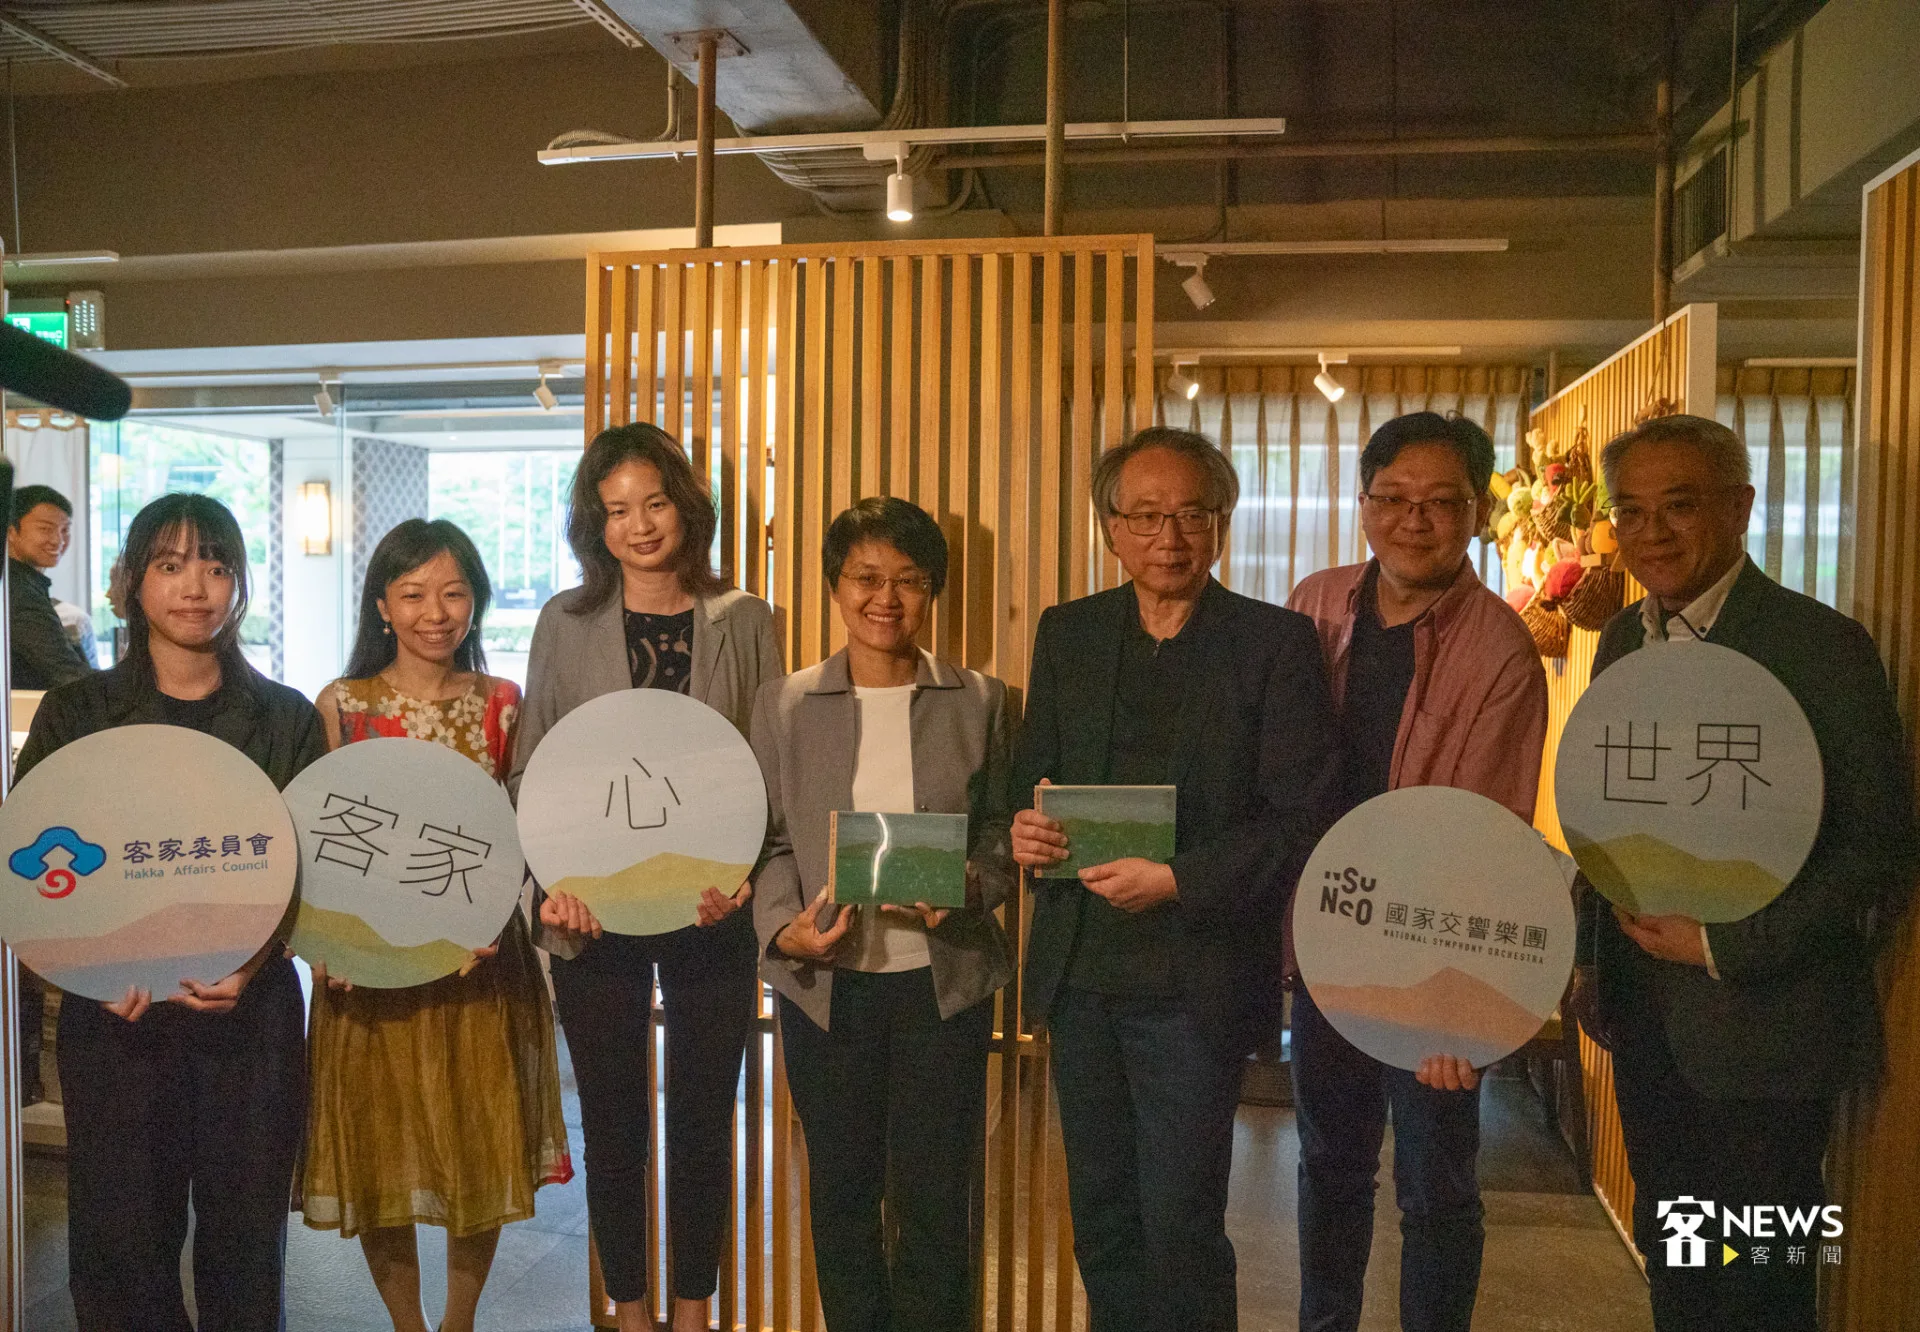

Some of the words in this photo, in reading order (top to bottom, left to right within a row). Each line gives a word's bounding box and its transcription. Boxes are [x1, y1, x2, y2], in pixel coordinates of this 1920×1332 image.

[1595, 721, 1771, 810] 世界
[605, 757, 681, 829] 心
[123, 832, 274, 864] 客家委員會
[124, 867, 165, 879] Hakka
[174, 864, 216, 876] Affairs
[222, 859, 268, 872] Council
[310, 793, 492, 904] 客家
[1383, 928, 1428, 944] NATIONAL
[1432, 937, 1483, 954] SYMPHONY
[1487, 946, 1545, 965] ORCHESTRA
[1385, 902, 1548, 950] 國家交響樂團
